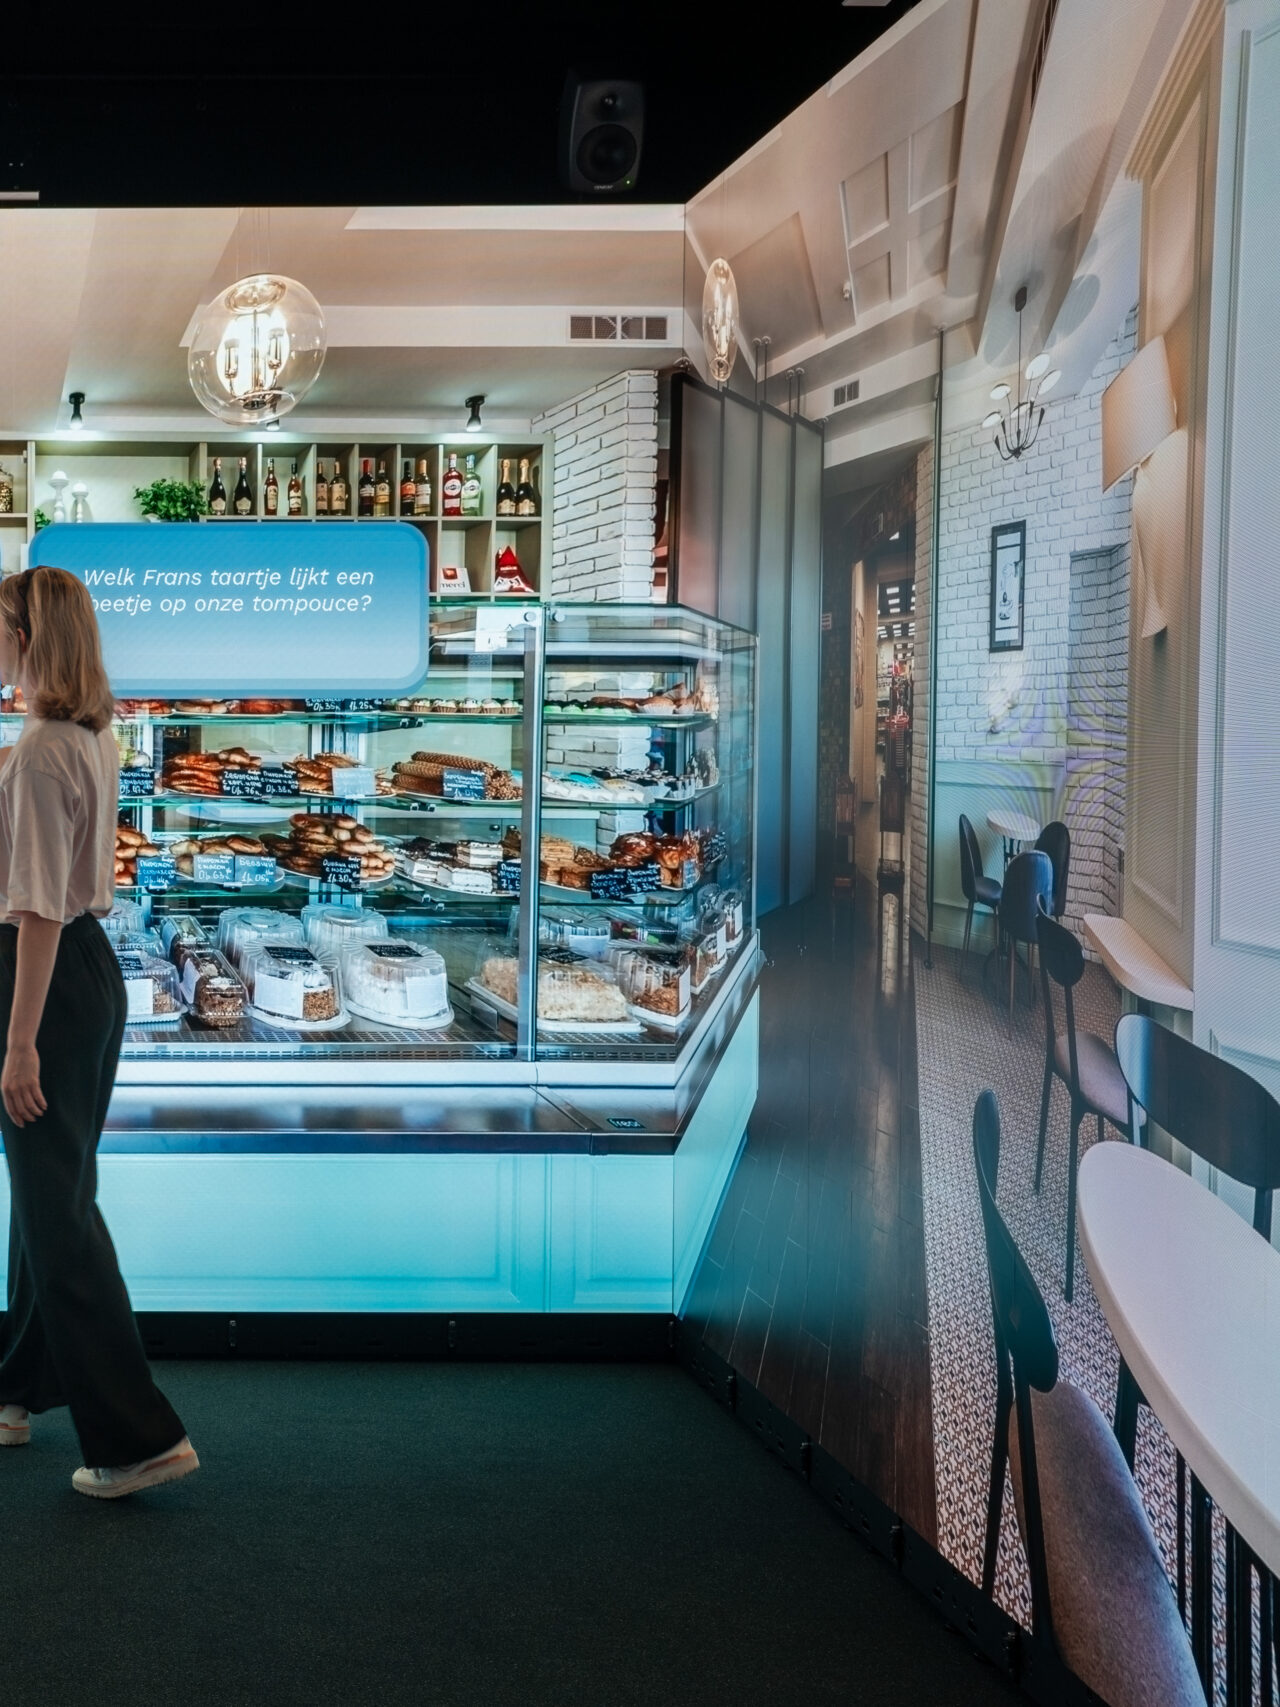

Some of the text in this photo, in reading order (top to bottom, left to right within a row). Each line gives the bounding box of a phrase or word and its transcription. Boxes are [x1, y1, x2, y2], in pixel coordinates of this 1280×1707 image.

[84, 566, 375, 590] Welk Frans taartje lijkt een
[160, 597, 187, 617] op
[194, 597, 245, 612] onze
[252, 595, 373, 616] tompouce?
